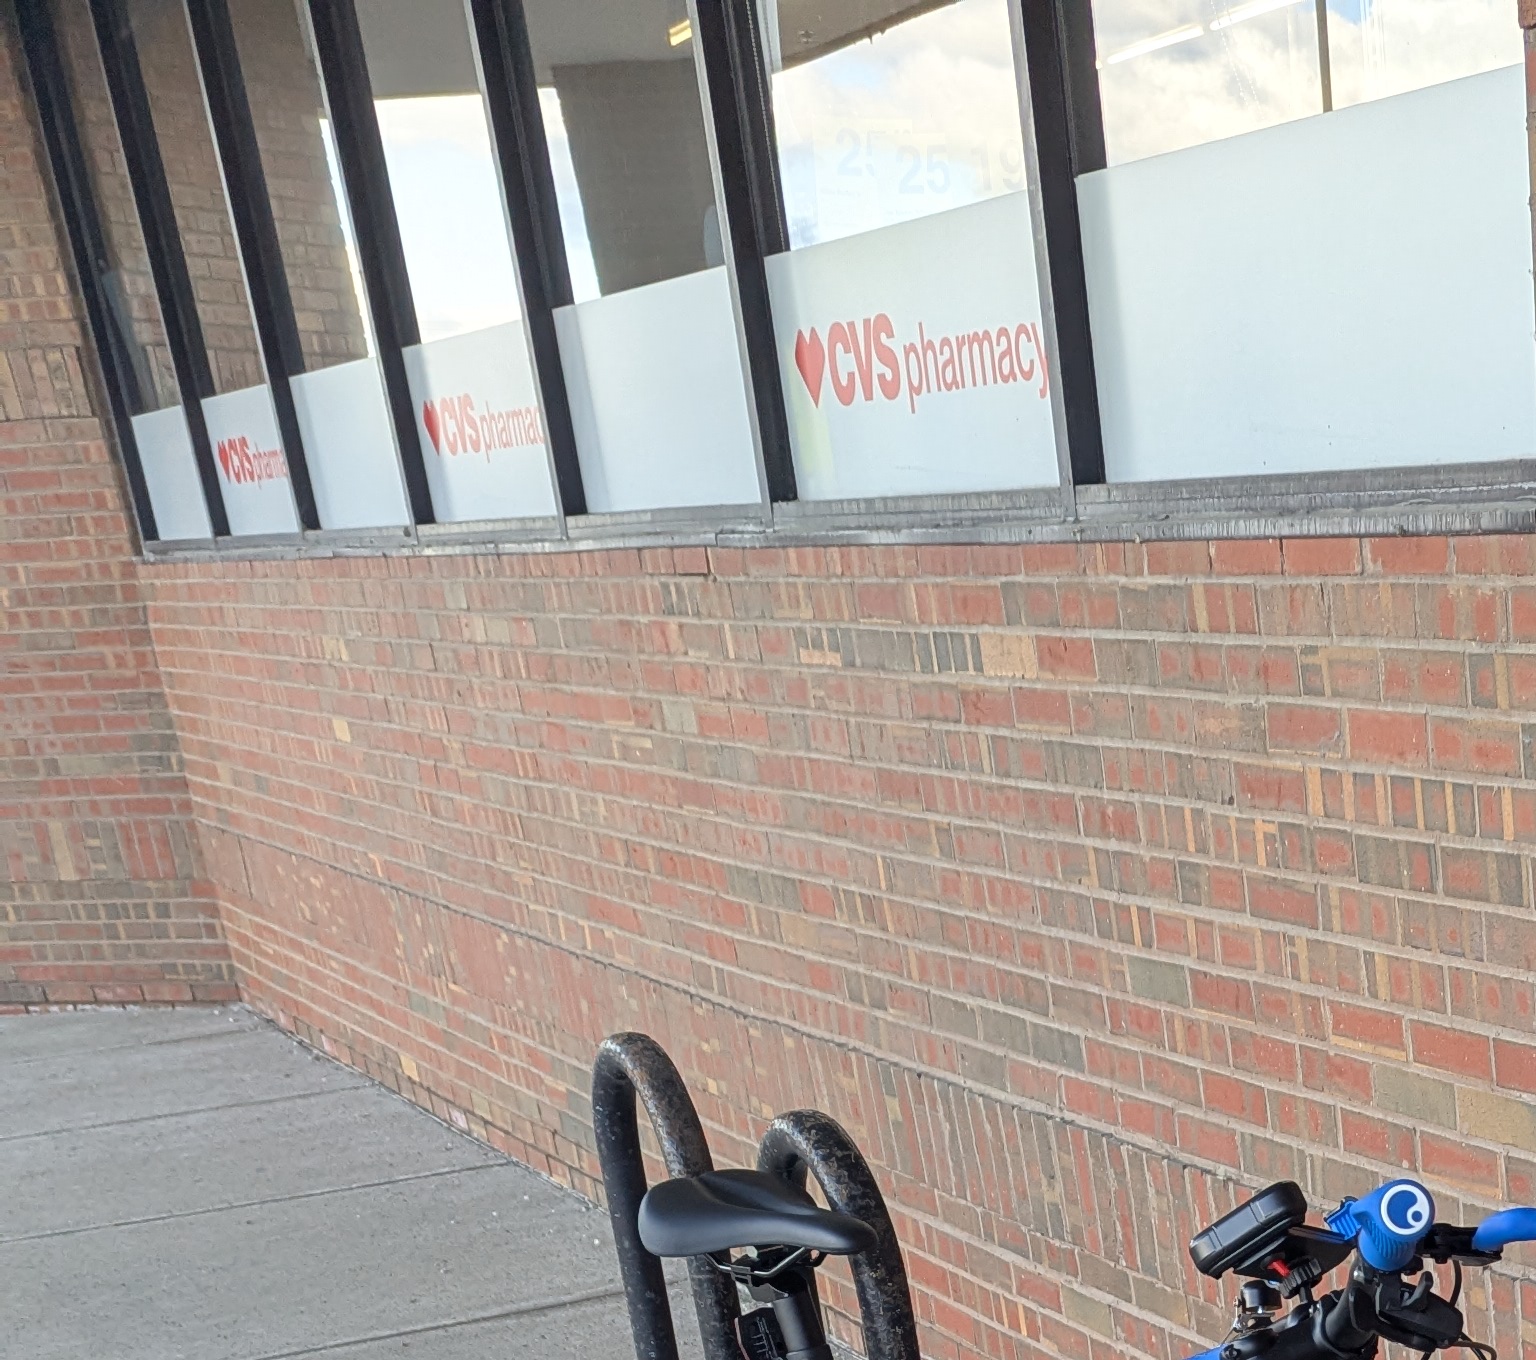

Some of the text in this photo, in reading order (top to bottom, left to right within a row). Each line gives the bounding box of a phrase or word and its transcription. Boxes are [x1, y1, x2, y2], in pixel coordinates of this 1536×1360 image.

[827, 312, 1050, 414] CVS pharmacy
[438, 392, 481, 457] CVS
[227, 436, 255, 484] CVS
